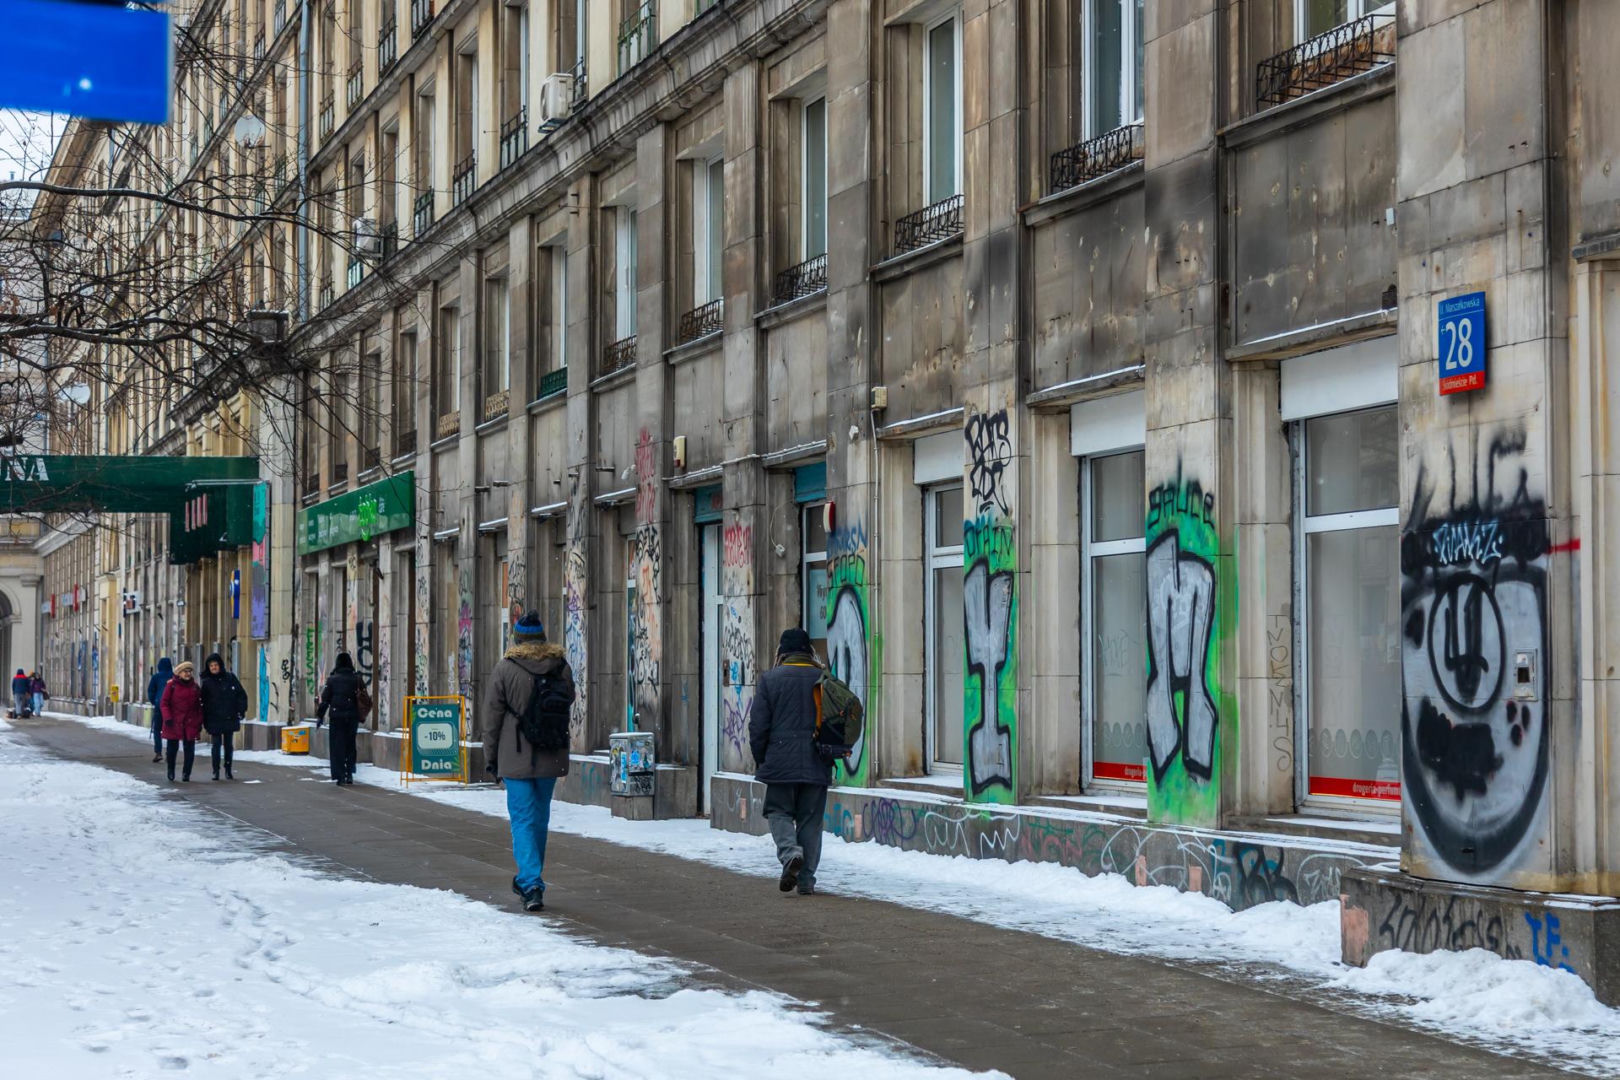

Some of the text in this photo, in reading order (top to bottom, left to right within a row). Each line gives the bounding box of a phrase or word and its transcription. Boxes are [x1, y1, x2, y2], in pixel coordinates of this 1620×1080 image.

[1445, 317, 1473, 370] 28
[0, 457, 49, 481] NA
[417, 708, 452, 718] Cena
[424, 731, 446, 741] -10%
[421, 759, 452, 770] Dnia
